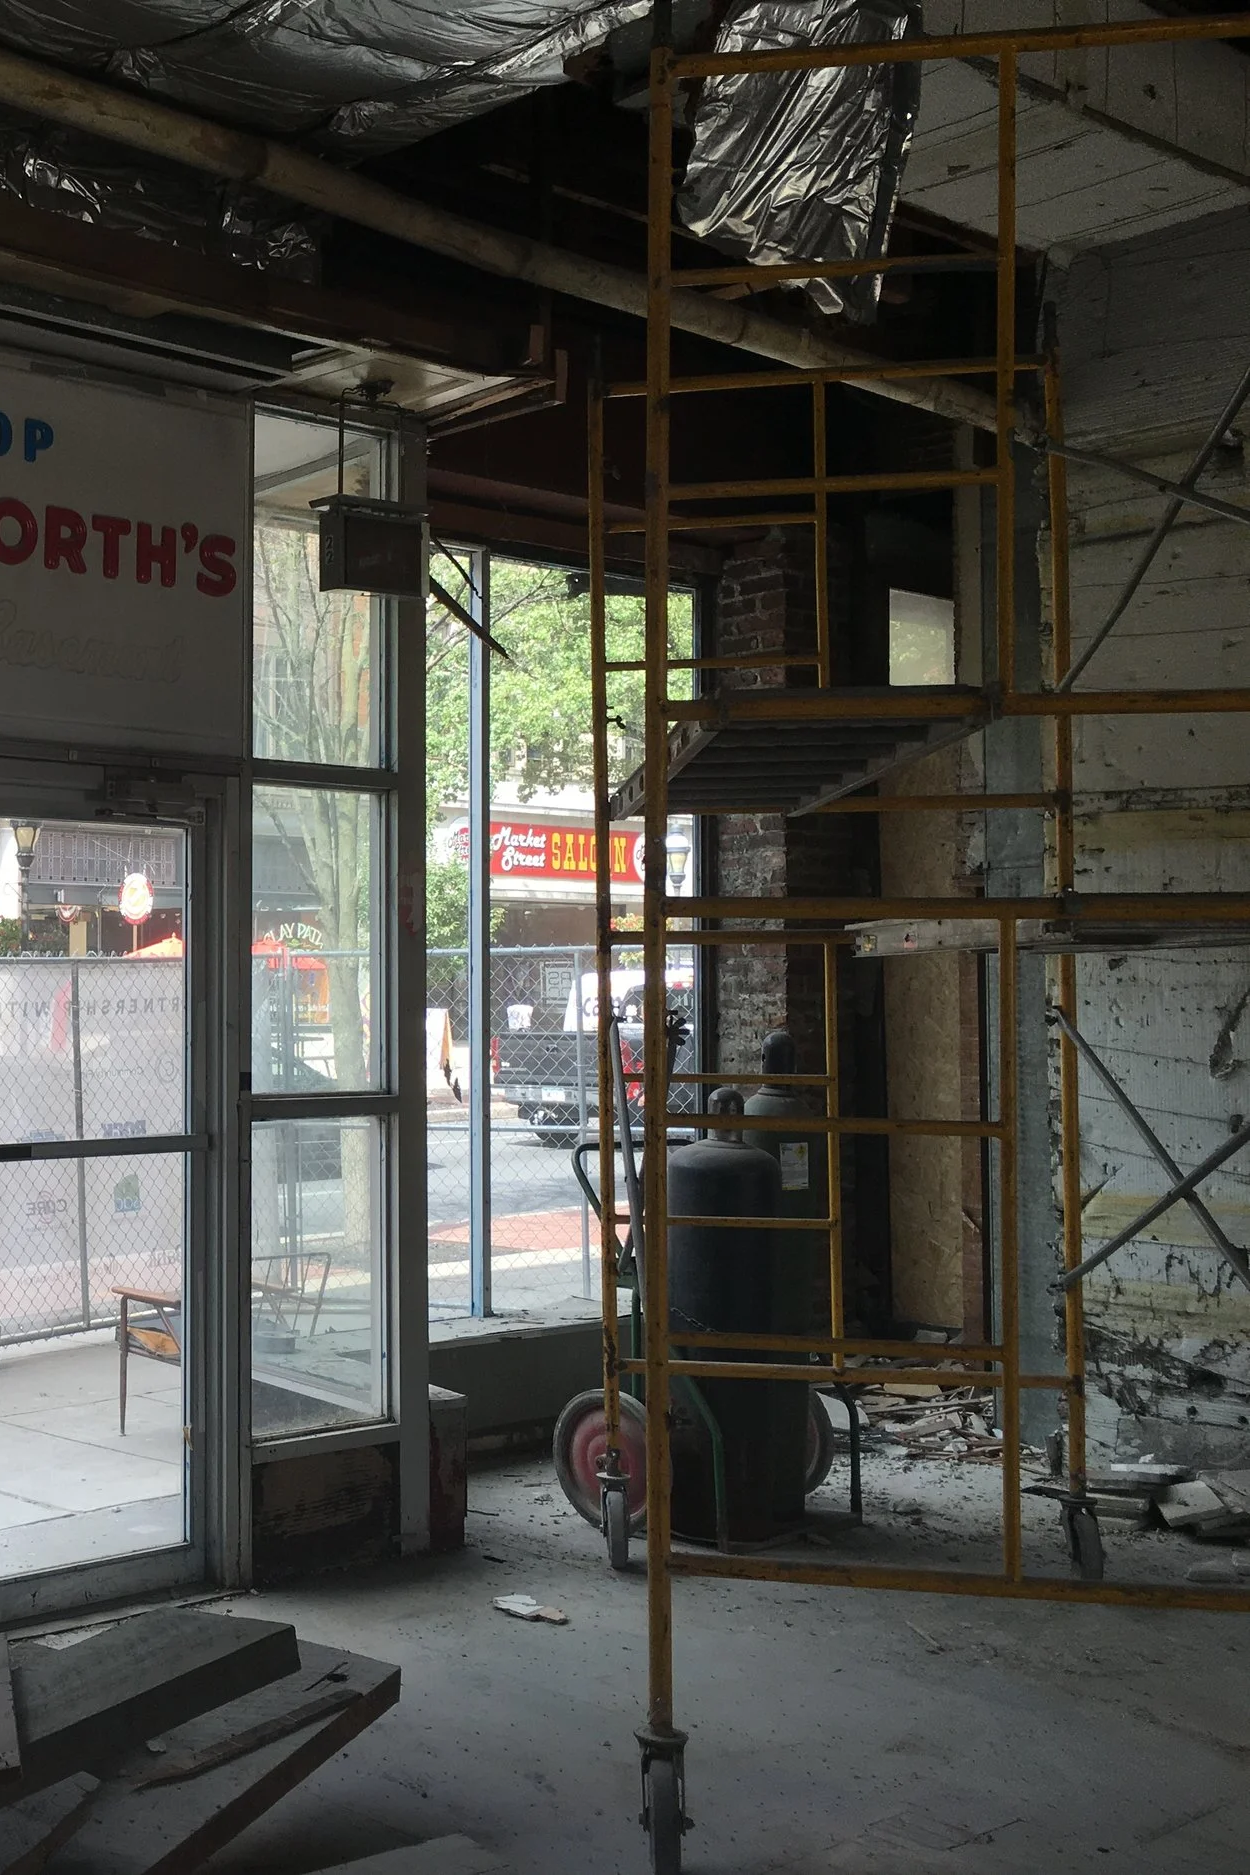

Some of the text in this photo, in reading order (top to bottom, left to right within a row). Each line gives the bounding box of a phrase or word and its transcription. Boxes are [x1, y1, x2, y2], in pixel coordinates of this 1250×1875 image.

[489, 826, 547, 852] Market
[501, 846, 546, 871] Street
[551, 832, 627, 873] SALON
